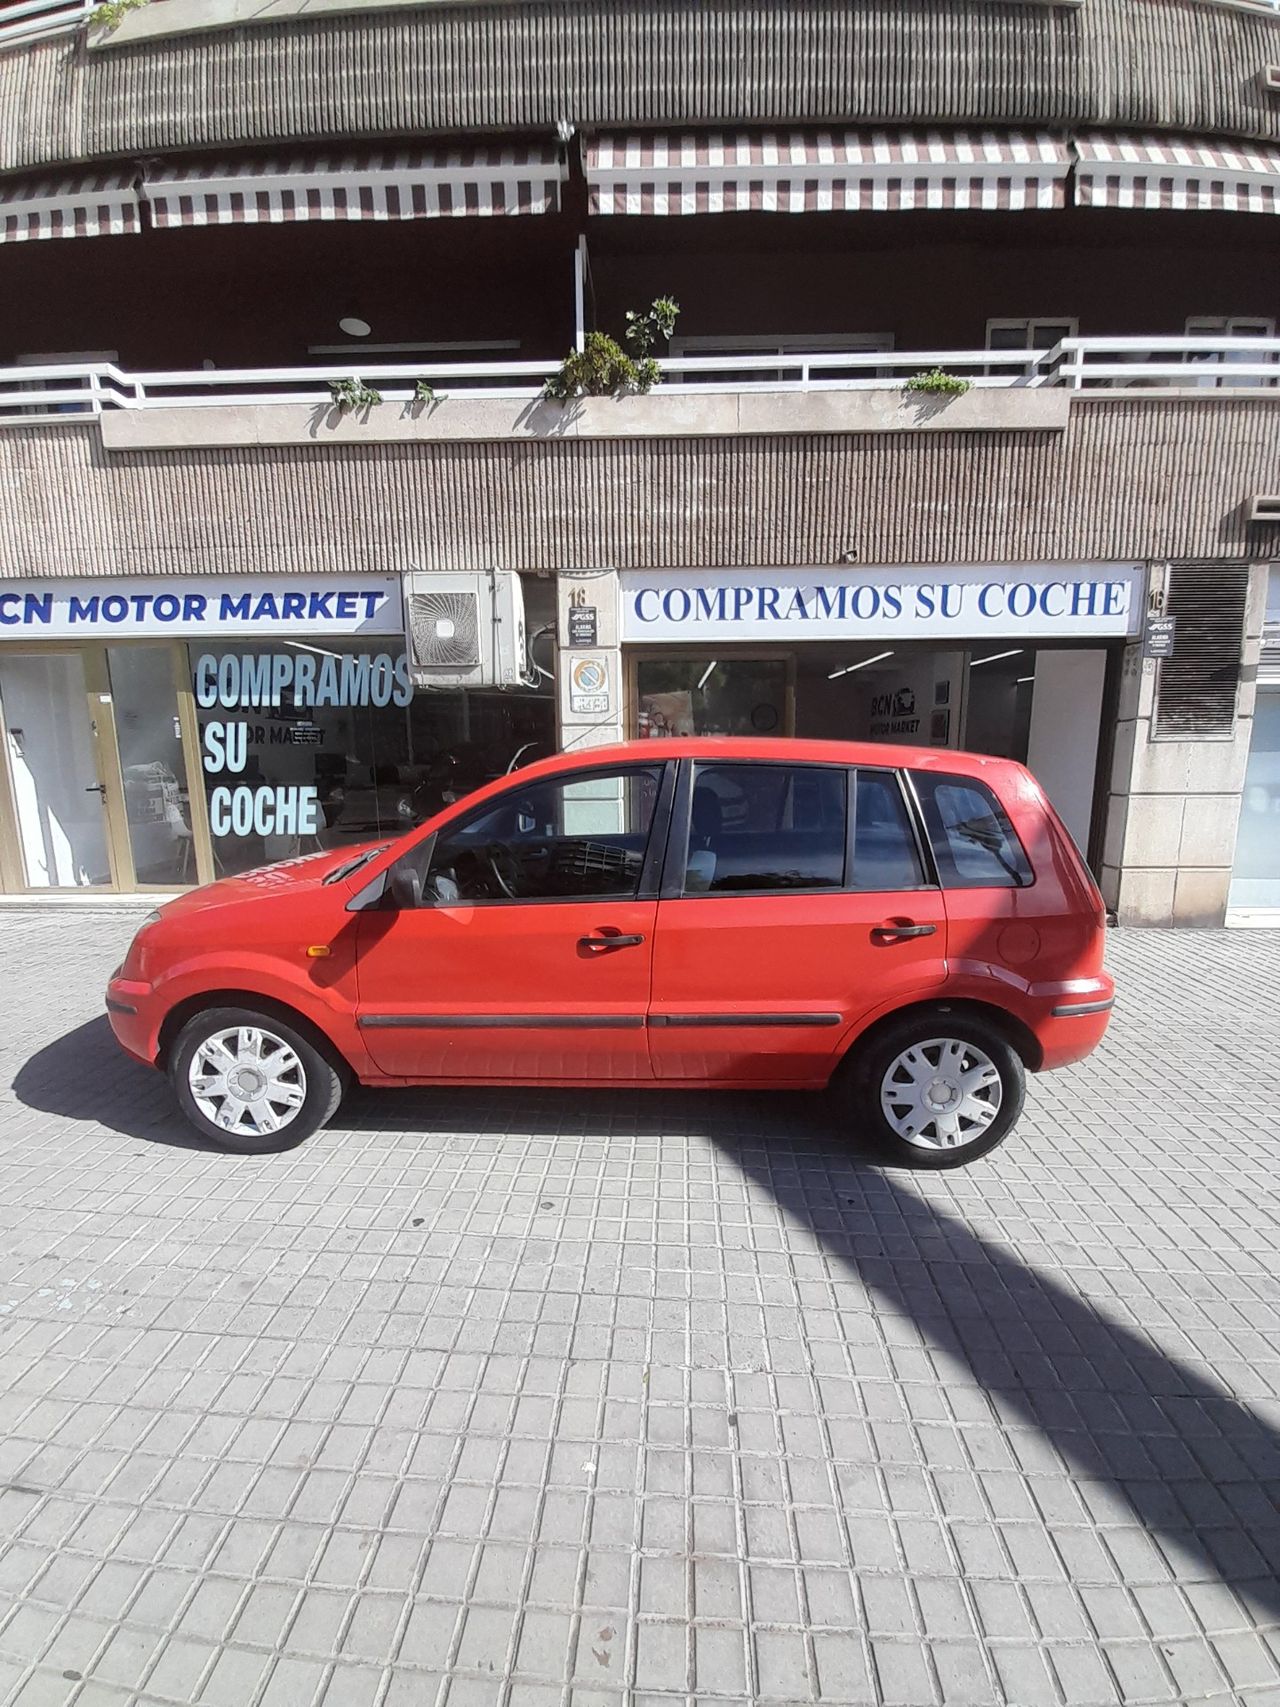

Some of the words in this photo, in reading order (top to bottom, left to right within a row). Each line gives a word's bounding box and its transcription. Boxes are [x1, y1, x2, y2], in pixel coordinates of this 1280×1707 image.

[69, 594, 207, 623] MOTOR
[219, 591, 384, 620] MARKET
[634, 585, 903, 623] COMPRAMOS
[915, 584, 965, 618] SU
[978, 582, 1126, 617] COCHE
[196, 654, 413, 708] COMPRAMOS
[203, 721, 248, 773] SU
[210, 786, 318, 837] COCHE
